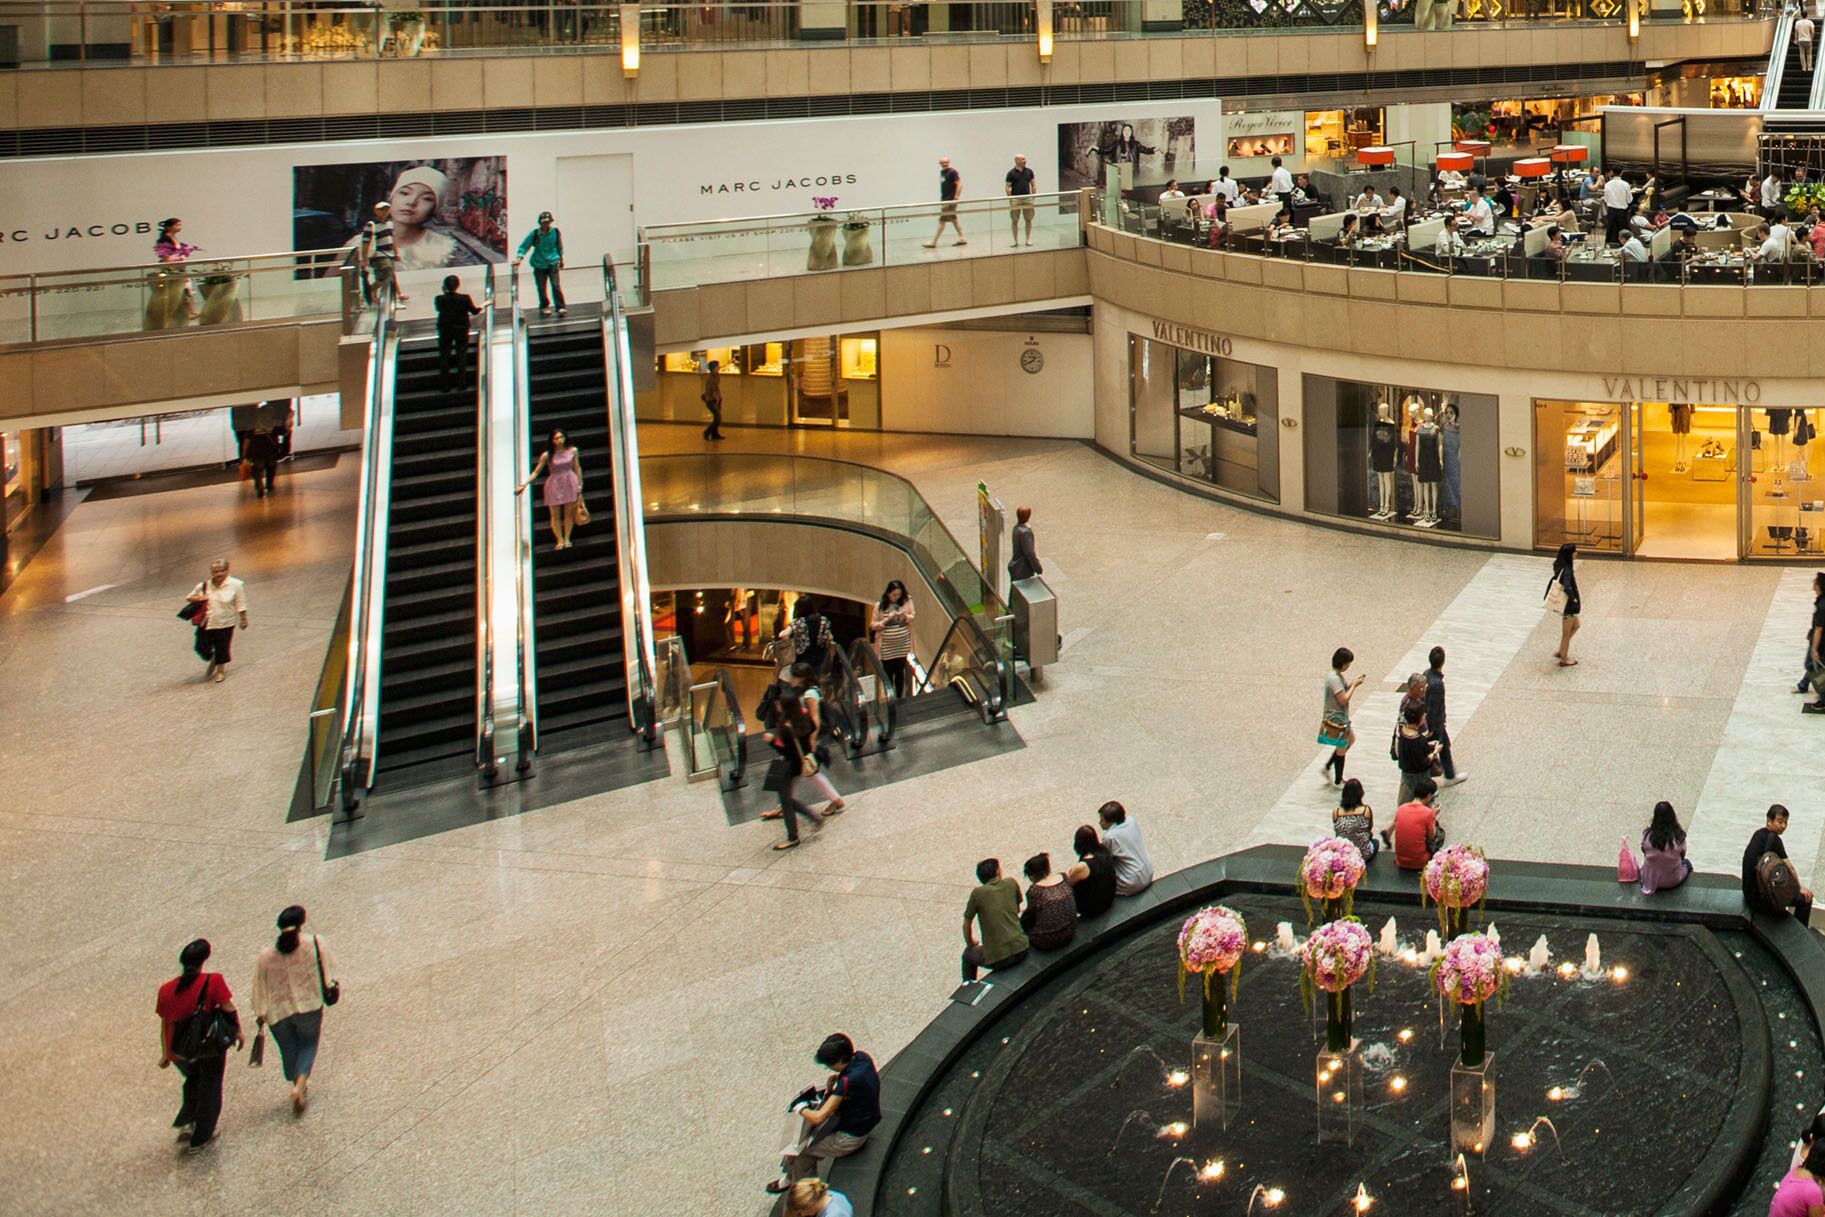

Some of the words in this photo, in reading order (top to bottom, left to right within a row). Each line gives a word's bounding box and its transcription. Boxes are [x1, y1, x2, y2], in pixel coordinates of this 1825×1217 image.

[1228, 118, 1264, 132] Roger
[1264, 115, 1293, 129] Vivier
[700, 181, 761, 195] MARC
[771, 174, 857, 190] JACOBS
[1152, 320, 1233, 356] VALENTINO
[1603, 378, 1761, 402] VALENTINO
